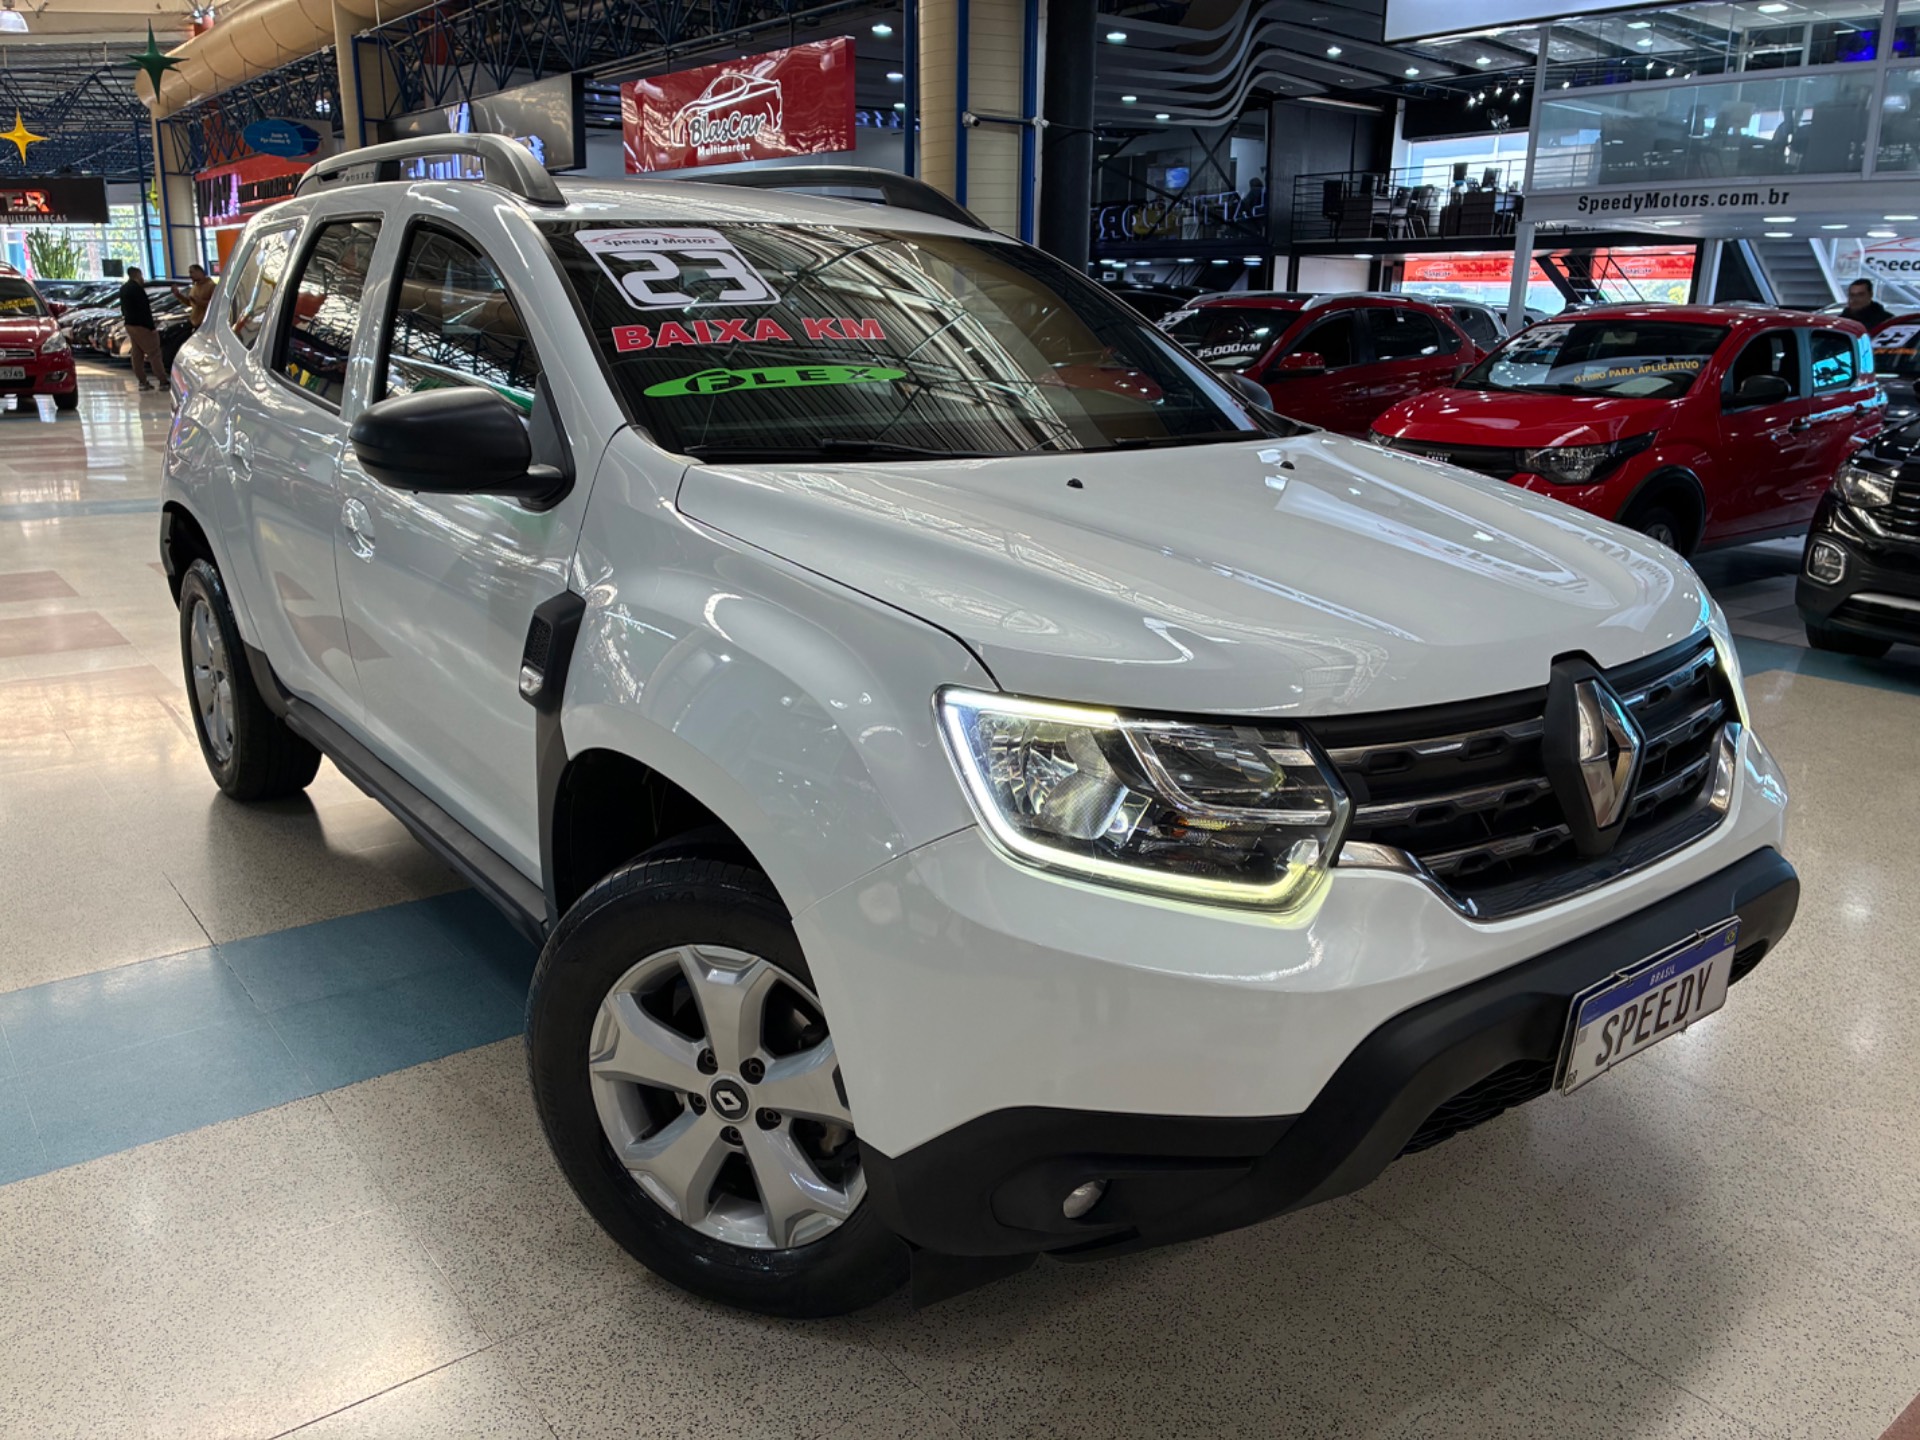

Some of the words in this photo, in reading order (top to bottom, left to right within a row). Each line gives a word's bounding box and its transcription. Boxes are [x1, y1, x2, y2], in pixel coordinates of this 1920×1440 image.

[689, 110, 767, 147] BlasCar
[697, 142, 751, 157] Multimarcas
[1577, 188, 1790, 214] SpeedyMotors.com.br
[603, 237, 659, 247] Speedy
[663, 236, 716, 246] Motors
[609, 251, 769, 304] 23
[611, 318, 793, 353] BAIXA
[801, 317, 887, 341] KM
[694, 368, 874, 393] FLEX
[1608, 367, 1635, 378] PARA
[1638, 360, 1700, 374] APLICATIVO
[1649, 964, 1677, 986] BRASIL
[1595, 961, 1714, 1067] SPEEDY
